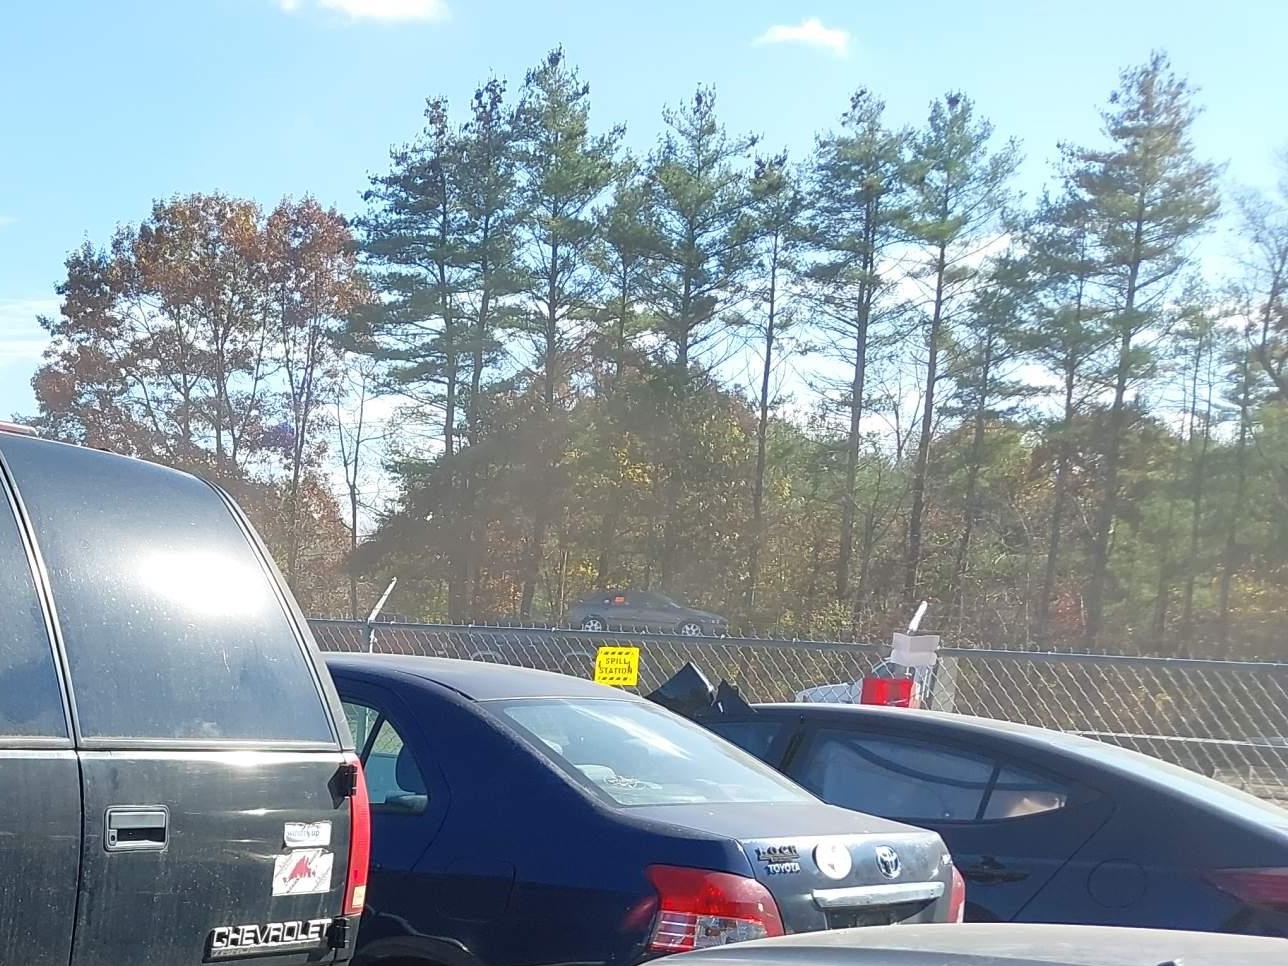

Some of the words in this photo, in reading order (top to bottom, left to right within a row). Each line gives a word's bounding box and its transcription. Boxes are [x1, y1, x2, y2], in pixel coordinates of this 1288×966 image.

[605, 657, 629, 665] SPILL
[599, 666, 633, 675] STATION
[767, 862, 801, 873] TOYOTA
[212, 918, 333, 948] CHEVROLET
